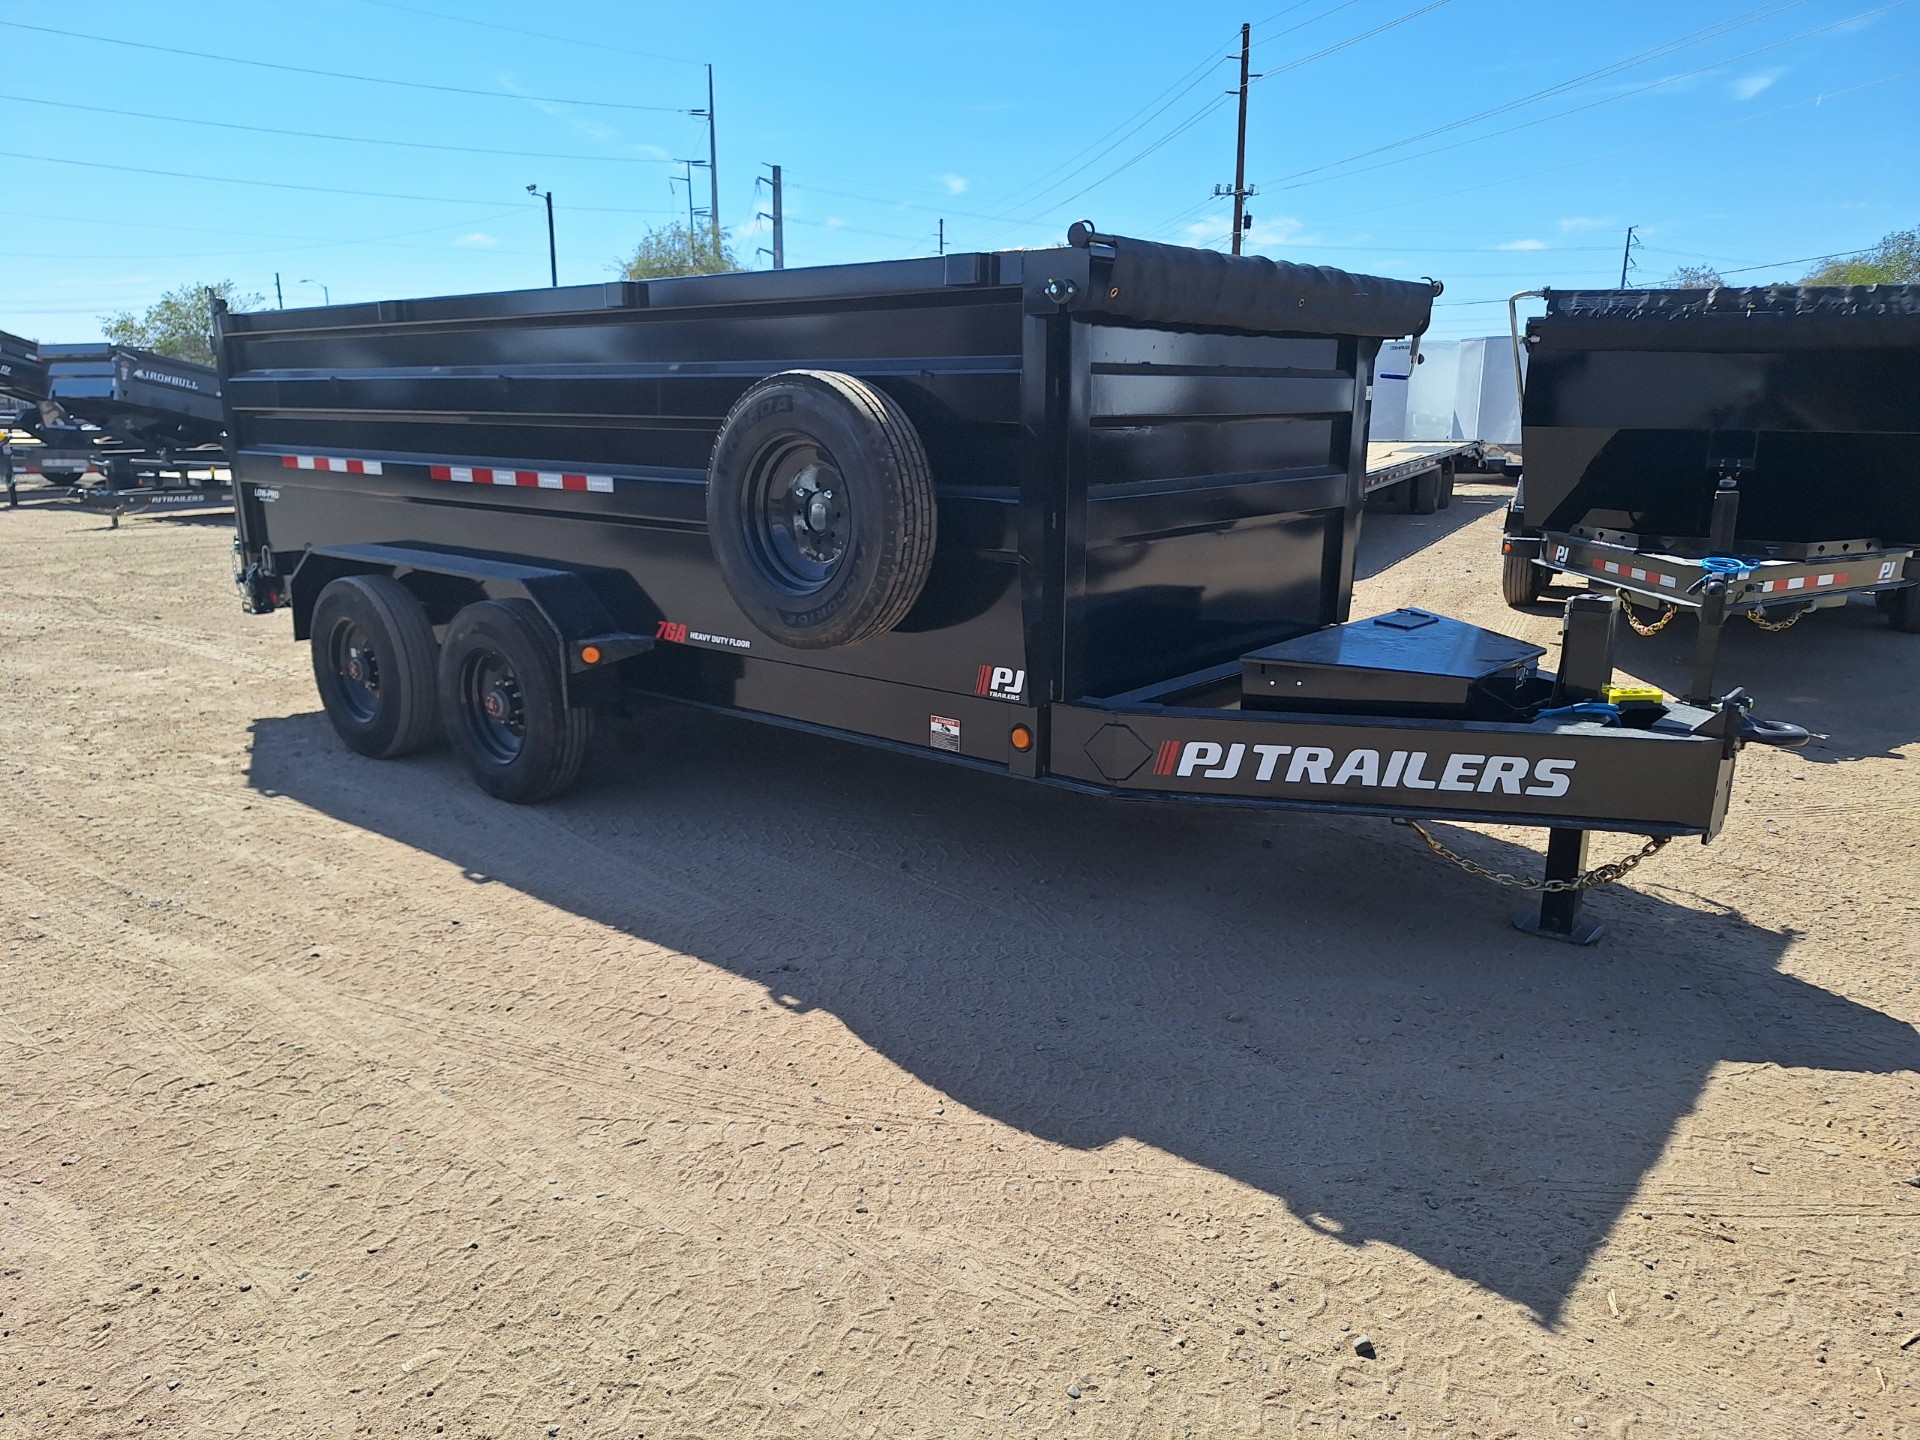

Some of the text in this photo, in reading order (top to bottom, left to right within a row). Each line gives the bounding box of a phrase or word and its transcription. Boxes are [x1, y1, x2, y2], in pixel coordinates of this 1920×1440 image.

[144, 371, 199, 390] IRONBULL
[162, 494, 205, 503] TRAILERS
[1555, 545, 1570, 563] PJ
[1878, 561, 1897, 580] PJ
[655, 620, 751, 649] 7GA HEAVY DUTY FLOOR
[990, 666, 1025, 694] PJ
[989, 691, 1020, 701] TRAILERS
[1176, 741, 1577, 797] PJ TRAILERS
